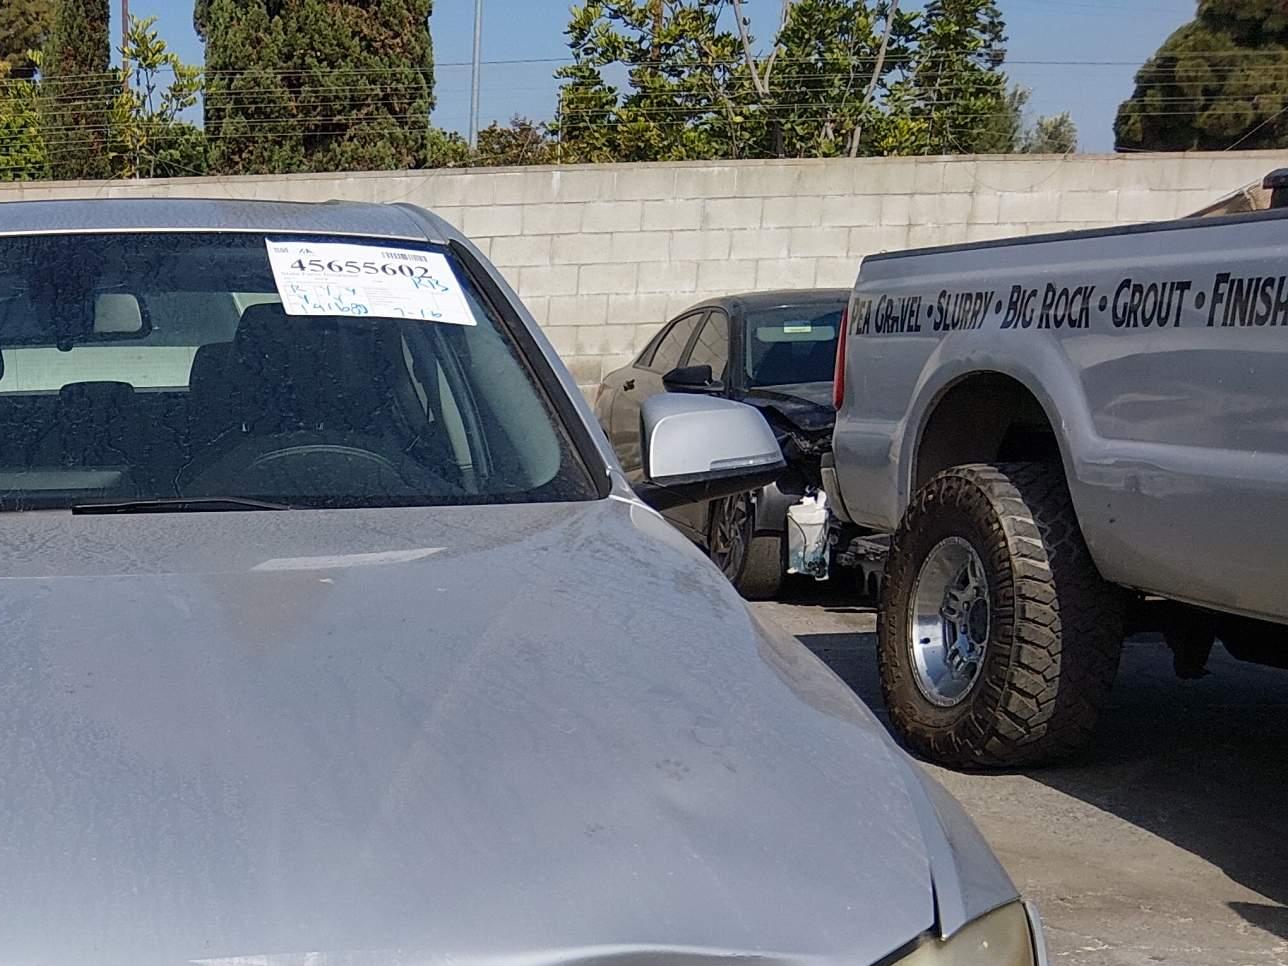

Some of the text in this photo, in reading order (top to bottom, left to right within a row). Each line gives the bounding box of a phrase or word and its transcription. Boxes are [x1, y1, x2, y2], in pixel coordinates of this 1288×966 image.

[291, 259, 432, 279] 45655602
[849, 297, 872, 335] PEA
[932, 290, 995, 331] SLURRY
[1000, 285, 1037, 329] BIG
[1038, 283, 1096, 328] ROCK
[1112, 278, 1192, 328] GROUT
[1207, 272, 1288, 327] FINISH
